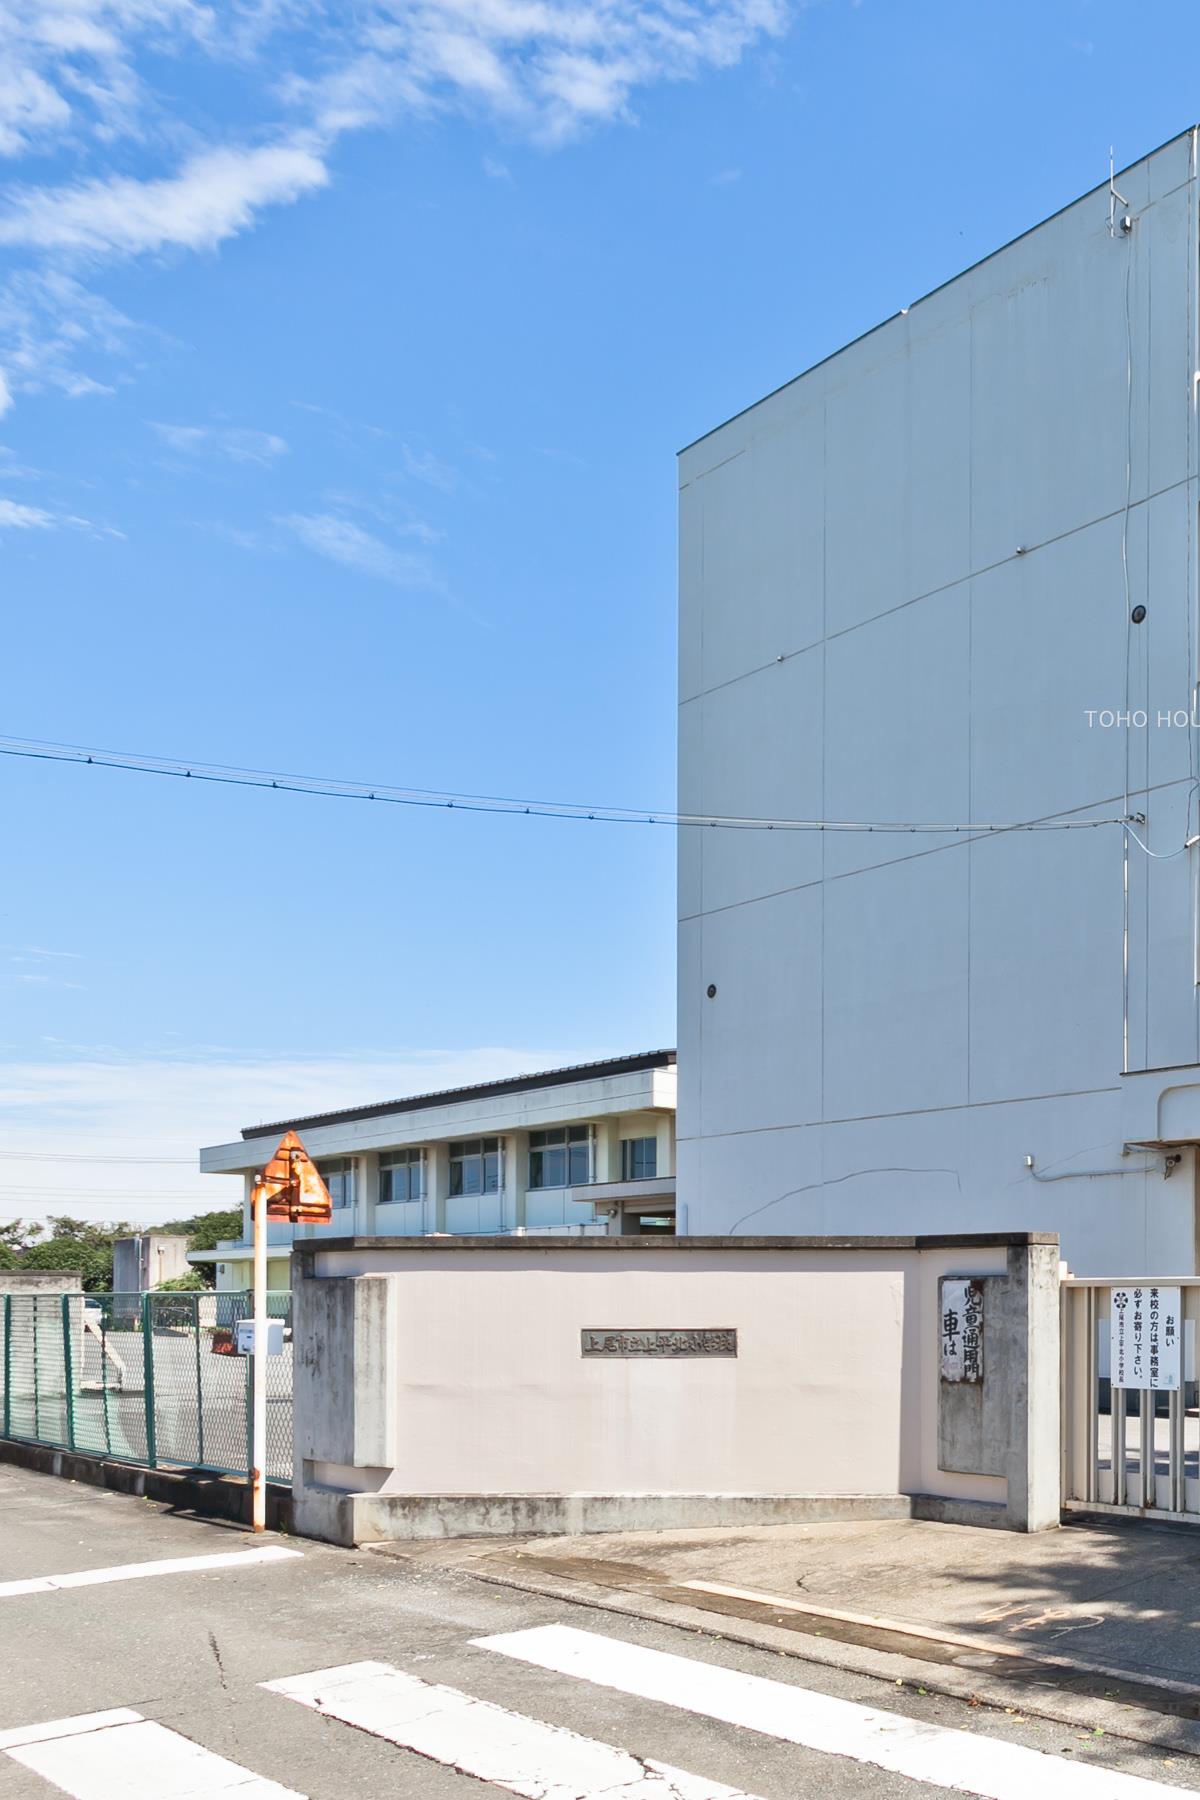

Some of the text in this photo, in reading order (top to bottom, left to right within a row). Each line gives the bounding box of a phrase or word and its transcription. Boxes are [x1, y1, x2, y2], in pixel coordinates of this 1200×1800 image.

[943, 1308, 960, 1356] 車は
[962, 1286, 982, 1378] 児童通用門
[1133, 1288, 1143, 1378] 必ずお寄り下さい。
[1165, 1315, 1175, 1347] お願い
